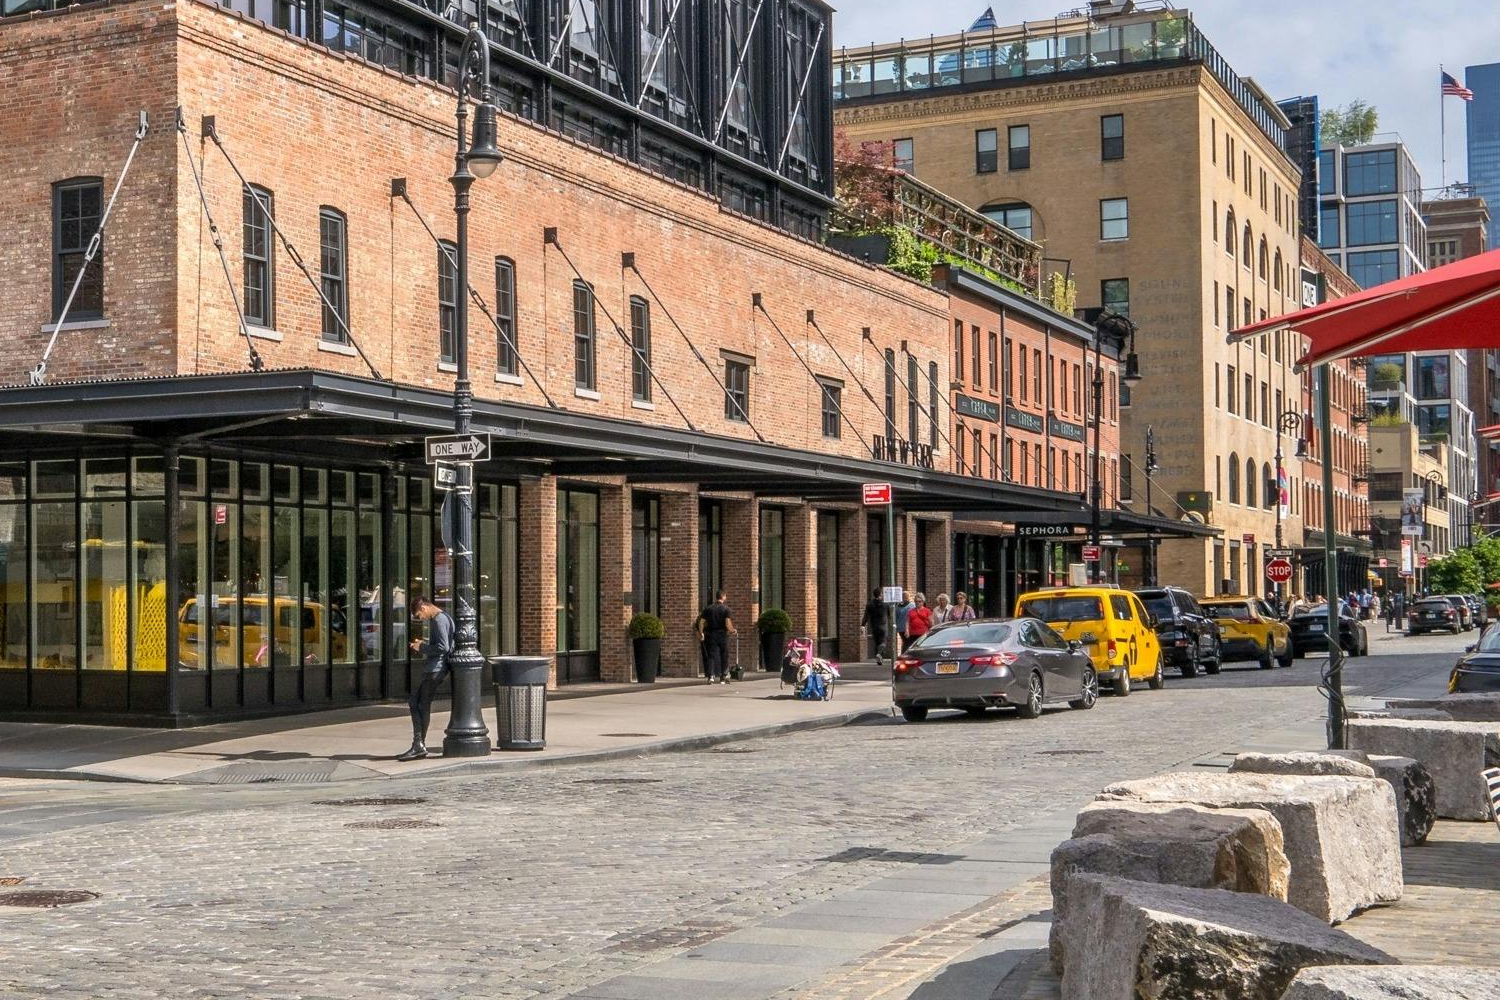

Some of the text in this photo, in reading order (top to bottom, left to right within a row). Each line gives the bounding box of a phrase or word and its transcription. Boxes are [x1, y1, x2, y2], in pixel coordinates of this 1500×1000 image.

[435, 442, 479, 455] ONE WAY
[1019, 526, 1069, 535] SEPHORA
[1268, 566, 1291, 576] STOP
